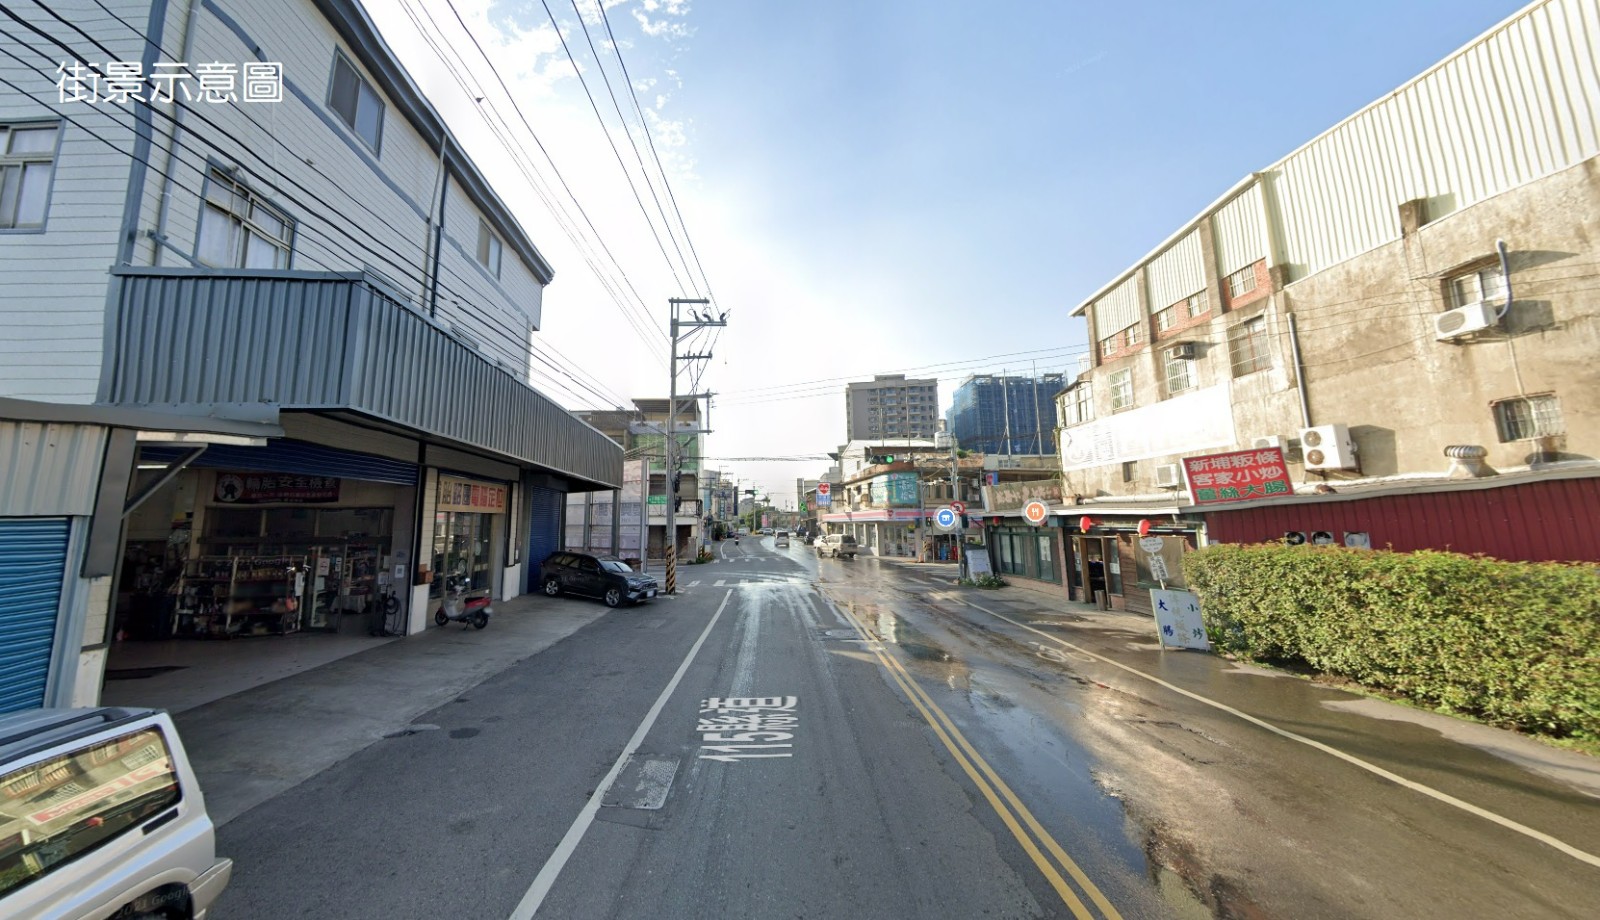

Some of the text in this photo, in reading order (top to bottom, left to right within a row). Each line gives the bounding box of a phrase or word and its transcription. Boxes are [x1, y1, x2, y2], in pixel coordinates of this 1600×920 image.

[1188, 450, 1280, 473] 新埔粄條
[1192, 465, 1284, 486] 客家小炒
[1195, 479, 1289, 501] 薑絲大腸
